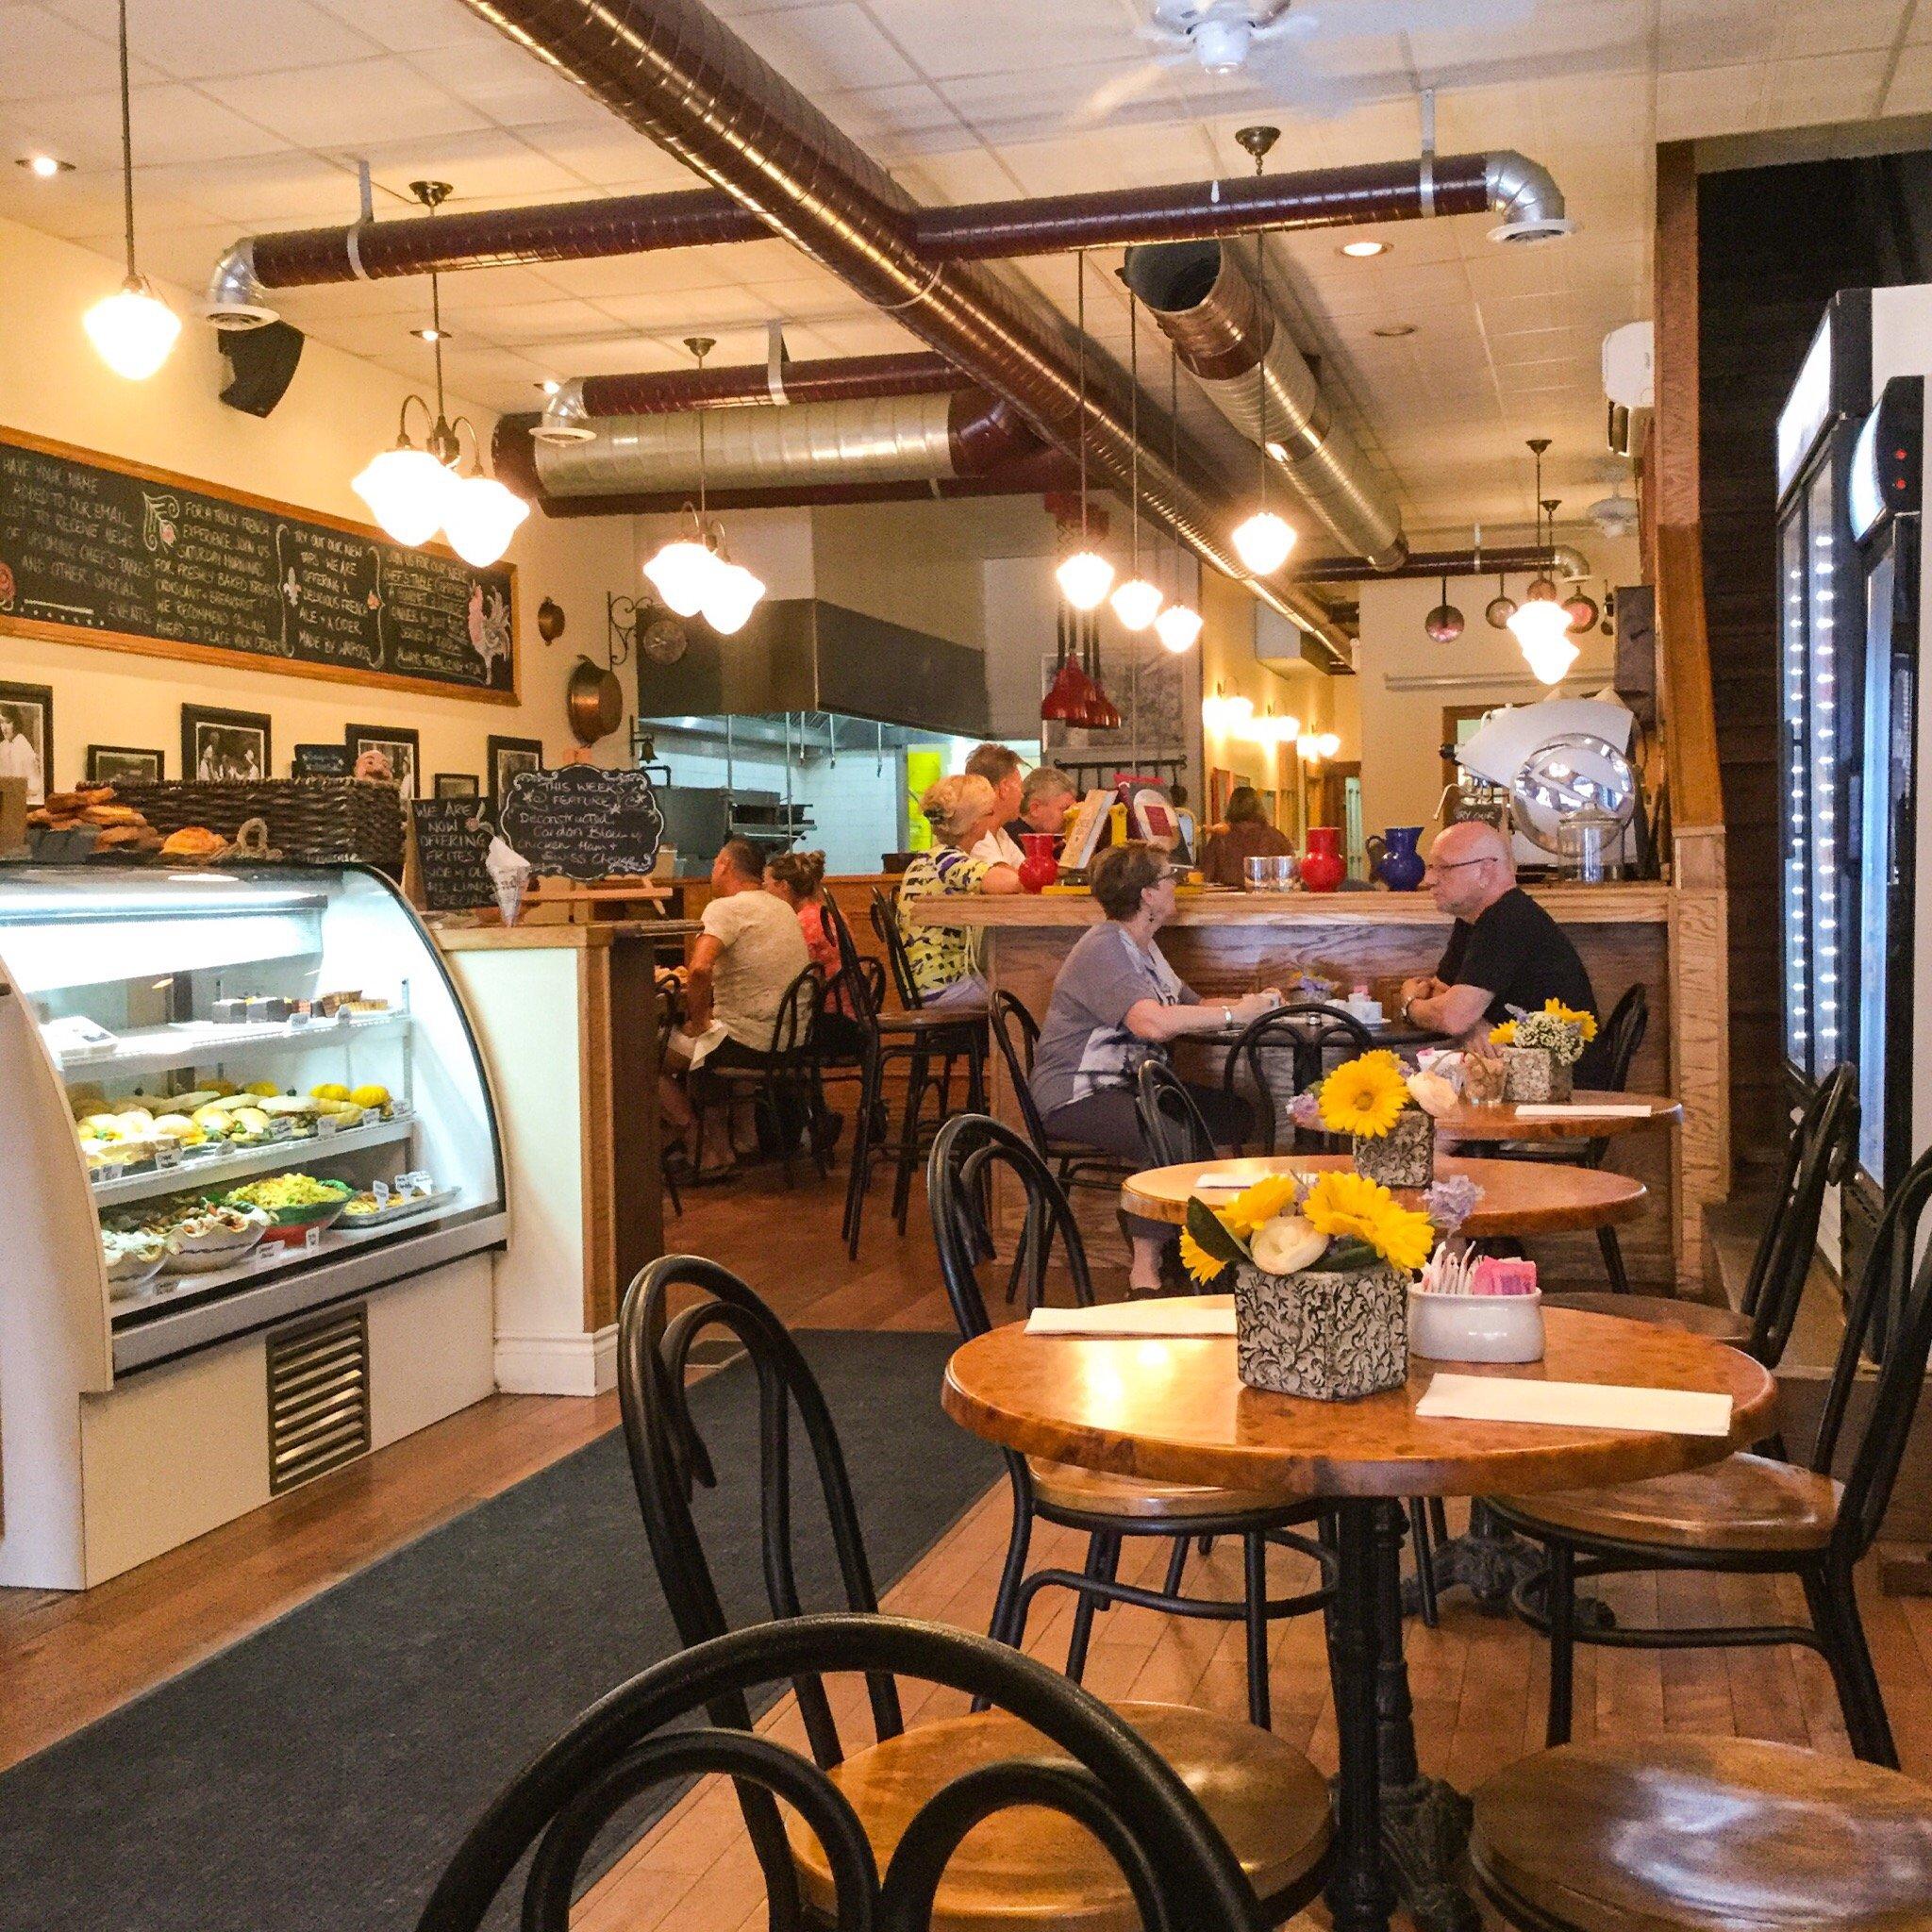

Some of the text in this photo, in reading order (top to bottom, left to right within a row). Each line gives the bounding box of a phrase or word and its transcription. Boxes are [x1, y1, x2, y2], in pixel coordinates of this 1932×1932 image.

[71, 496, 92, 518] OUR
[94, 503, 132, 528] EMAIL
[540, 782, 571, 791] THIS
[415, 801, 472, 818] WE ARE
[427, 819, 458, 832] NOW
[533, 825, 583, 837] Cordon
[421, 833, 485, 847] OFFERING
